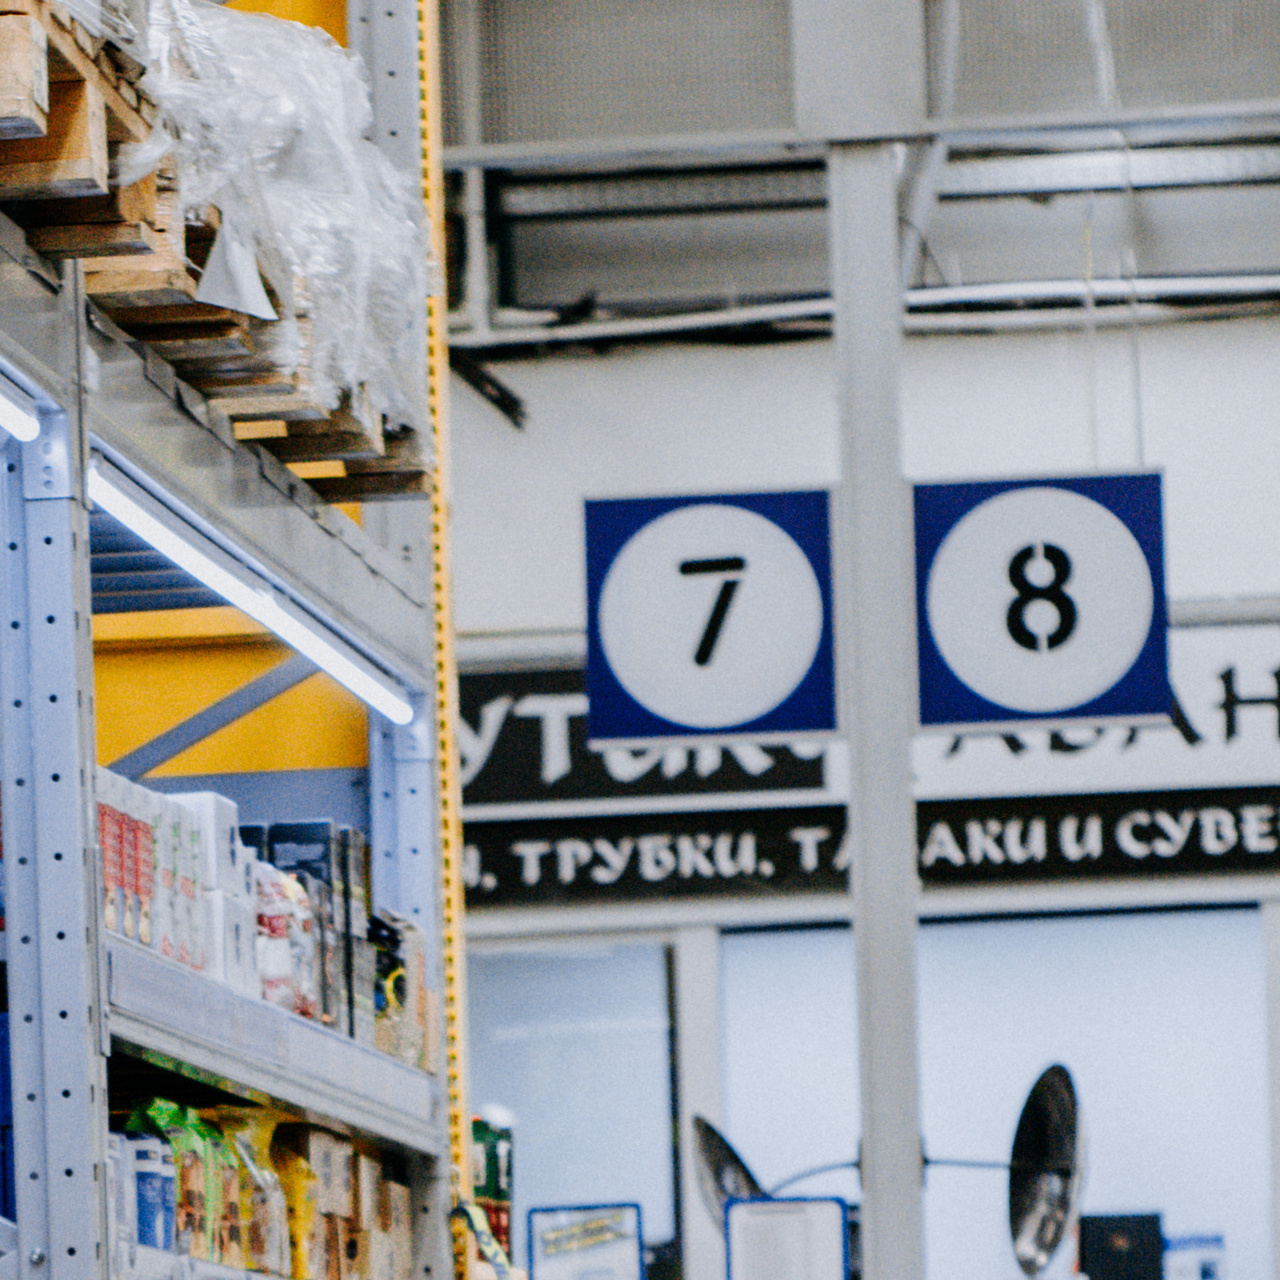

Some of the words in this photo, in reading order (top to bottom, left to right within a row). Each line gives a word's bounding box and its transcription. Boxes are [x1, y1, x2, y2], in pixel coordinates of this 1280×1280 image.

[680, 557, 746, 666] 7
[1007, 543, 1077, 652] 8
[1115, 804, 1280, 859] СУВЕ
